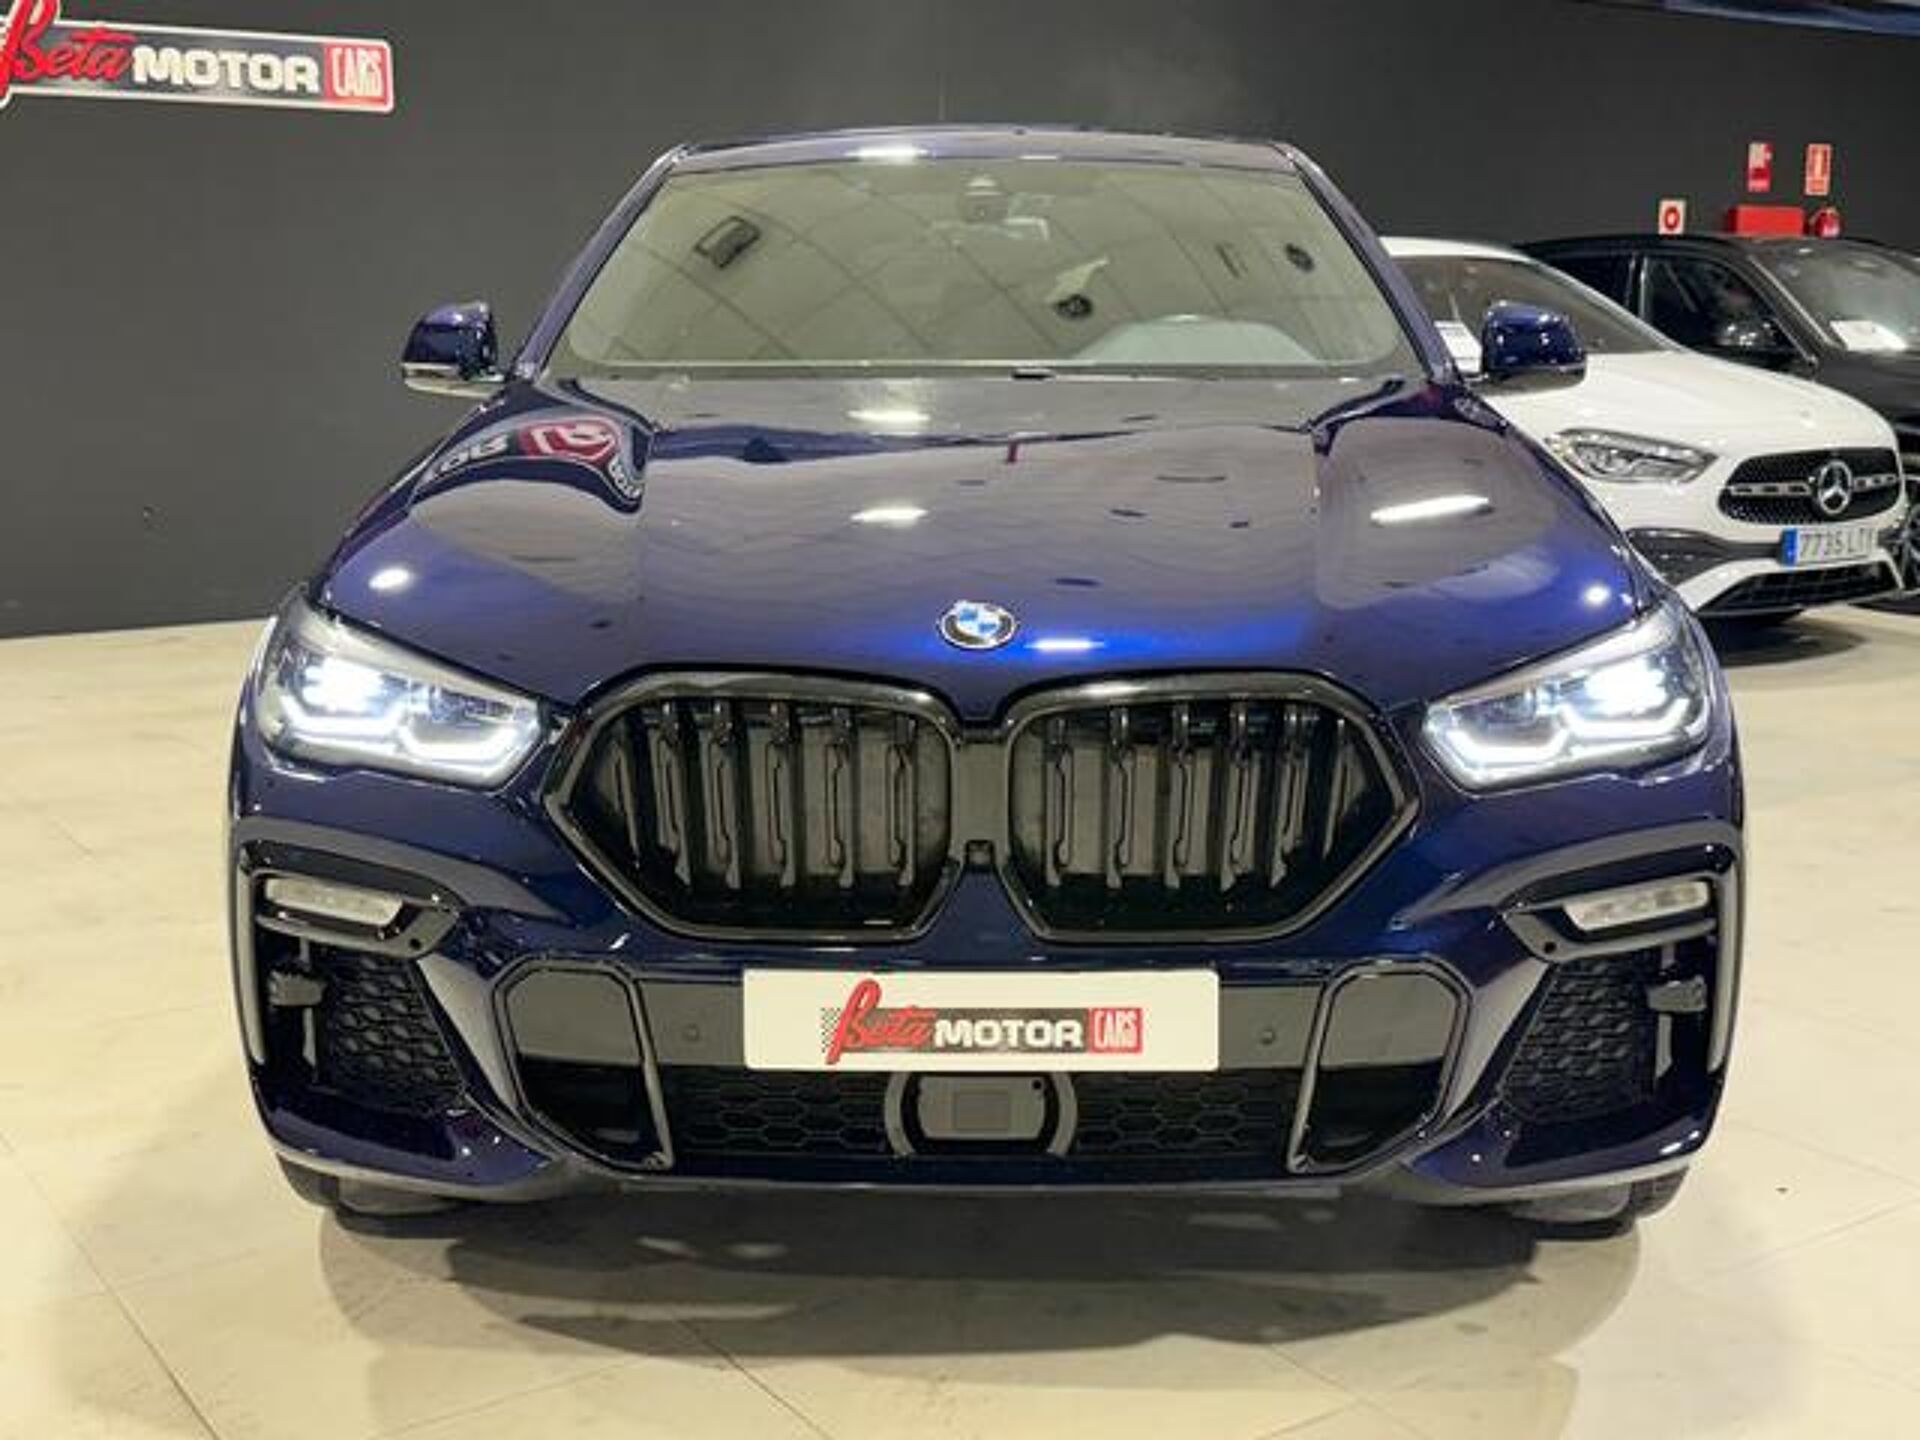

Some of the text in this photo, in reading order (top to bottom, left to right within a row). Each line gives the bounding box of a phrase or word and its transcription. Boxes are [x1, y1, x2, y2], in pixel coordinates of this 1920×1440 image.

[133, 45, 320, 93] MOTOR
[331, 46, 385, 98] CARS
[825, 979, 1138, 1065] Beta MOTOR CARS
